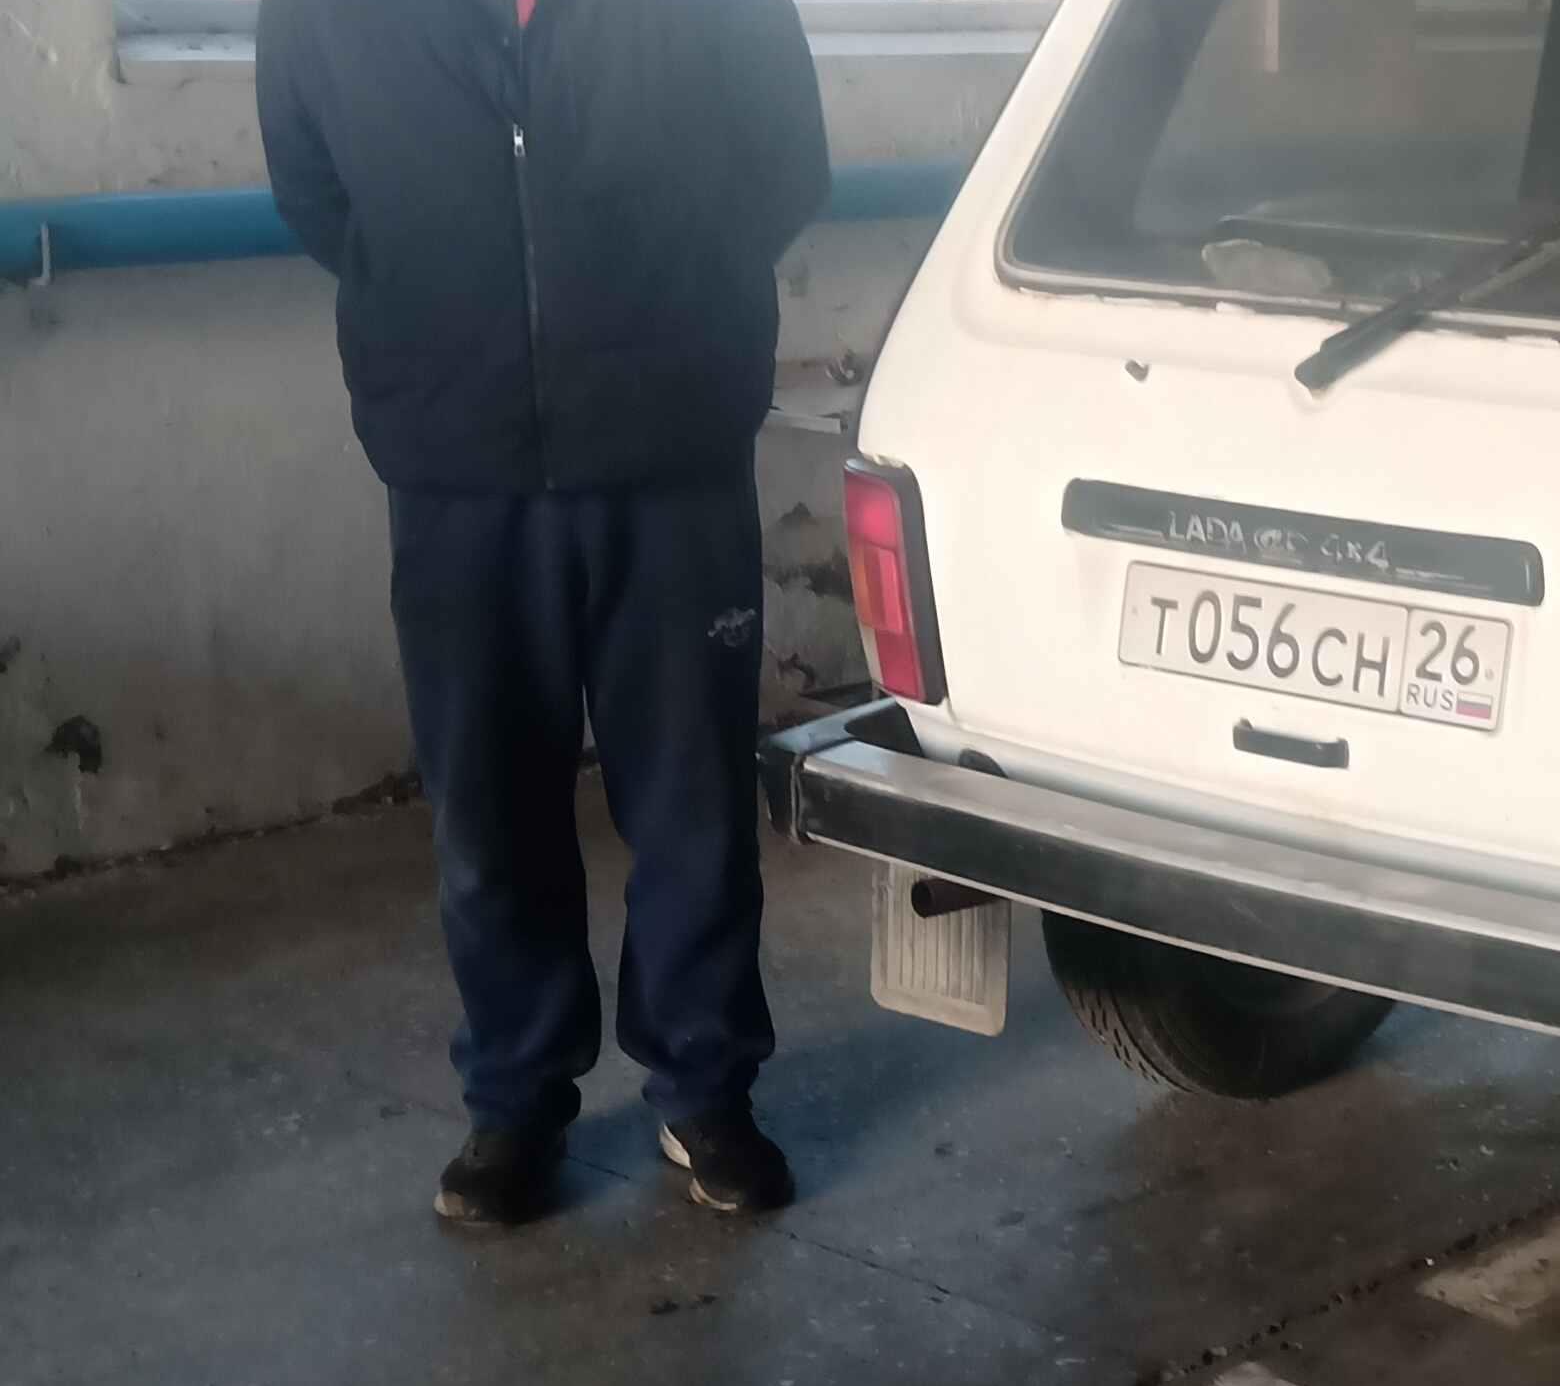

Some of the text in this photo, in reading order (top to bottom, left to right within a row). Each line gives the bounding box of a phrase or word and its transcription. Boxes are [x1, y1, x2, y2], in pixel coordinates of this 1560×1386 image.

[1169, 511, 1246, 555] LADA
[1415, 621, 1480, 685] 26
[1407, 683, 1454, 711] RUS
